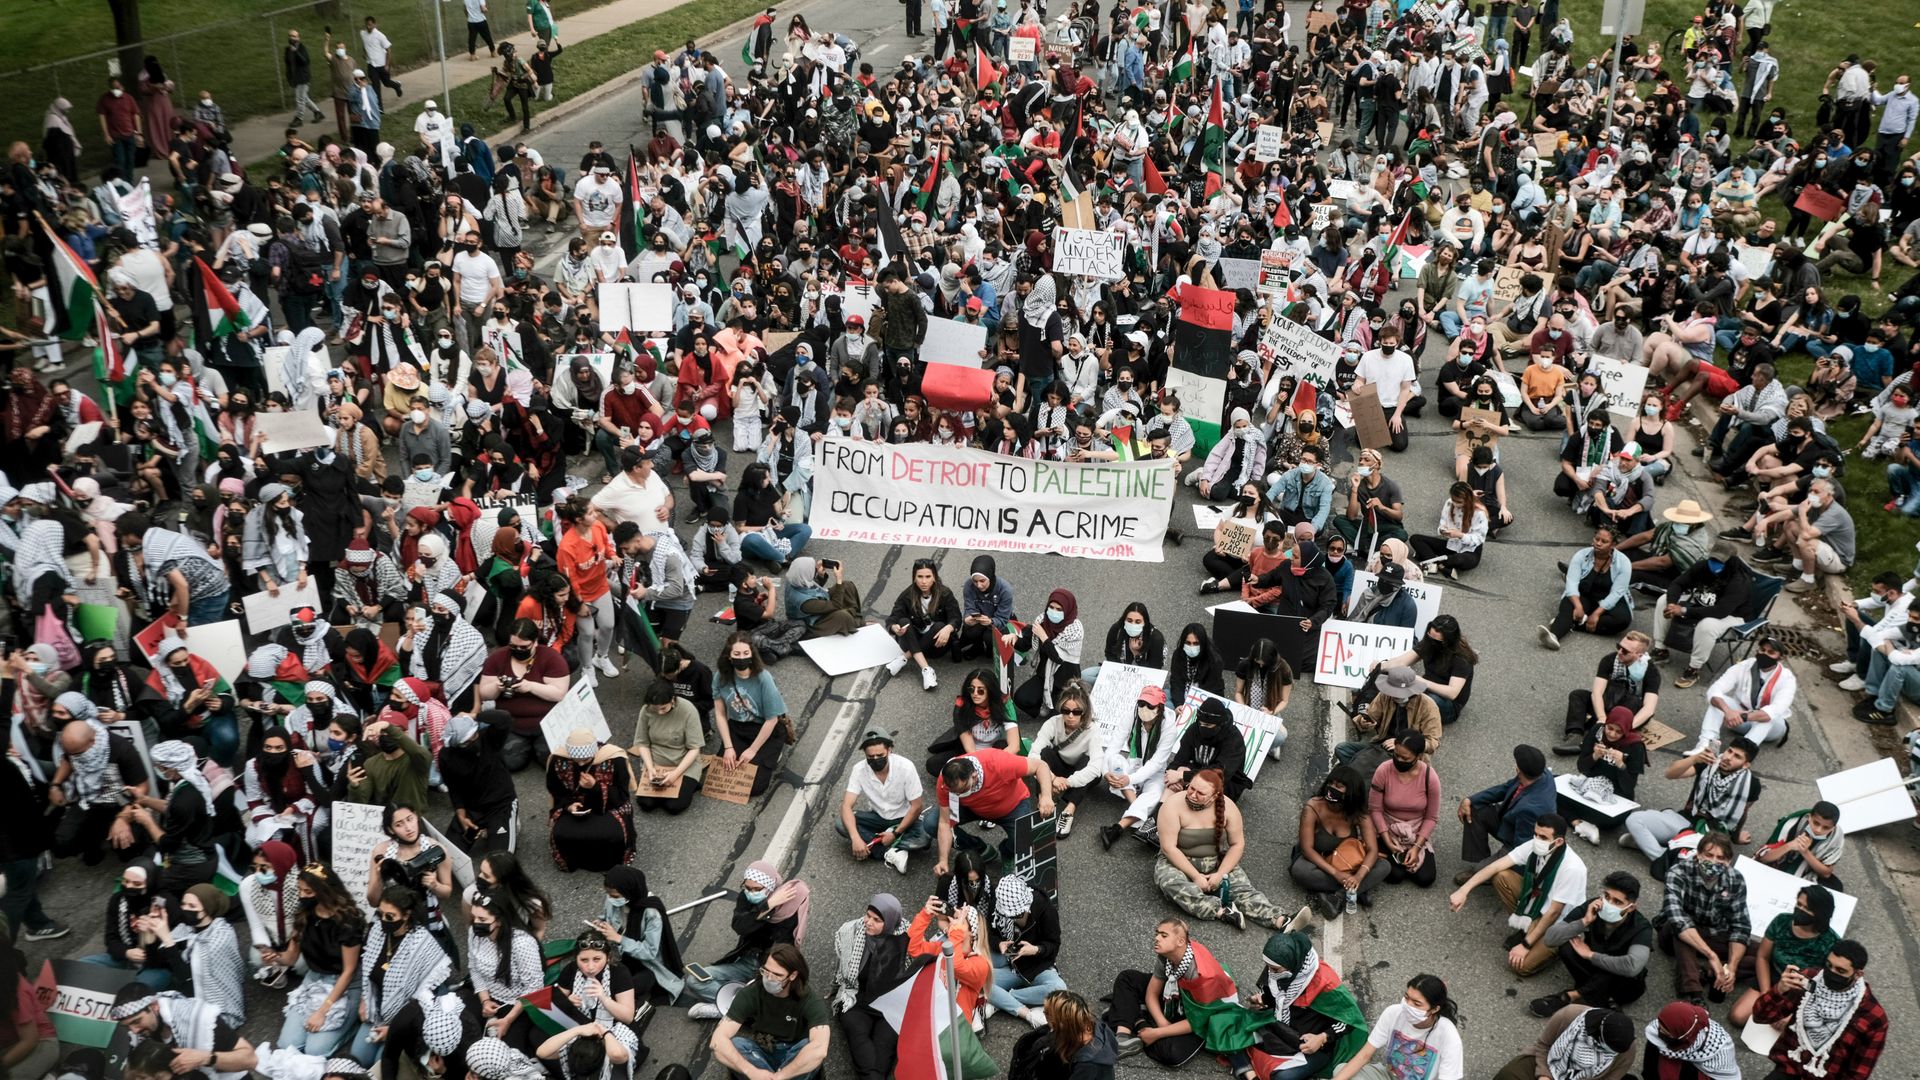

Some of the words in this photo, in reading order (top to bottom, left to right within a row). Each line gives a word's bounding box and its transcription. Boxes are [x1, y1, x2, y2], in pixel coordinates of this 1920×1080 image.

[1072, 230, 1114, 247] GAZA
[1063, 243, 1116, 260] UNDER
[1057, 257, 1119, 275] ATTACK
[1273, 313, 1294, 331] YOUR
[1294, 326, 1337, 355] FREEDOM
[1268, 336, 1278, 347] THE
[1280, 344, 1307, 363] FREEDOM
[1306, 350, 1332, 368] WITHOUT
[822, 441, 884, 477] FROM
[891, 451, 992, 488] DETROIT
[994, 461, 1027, 493] TO
[1032, 461, 1171, 501] PALESTINE
[474, 492, 536, 510] ALESTINE
[831, 490, 990, 531] OCCUPATION
[998, 507, 1019, 535] IS
[1026, 508, 1051, 538] A
[1055, 510, 1139, 540] CRIME
[819, 528, 841, 538] US
[848, 531, 958, 546] PALESTINIAN
[967, 538, 1053, 549] COMMUNITY
[1060, 544, 1136, 557] NETWORK
[1222, 528, 1251, 544] JUSTICE
[1229, 539, 1241, 547] NO
[1218, 541, 1246, 555] PEACE!
